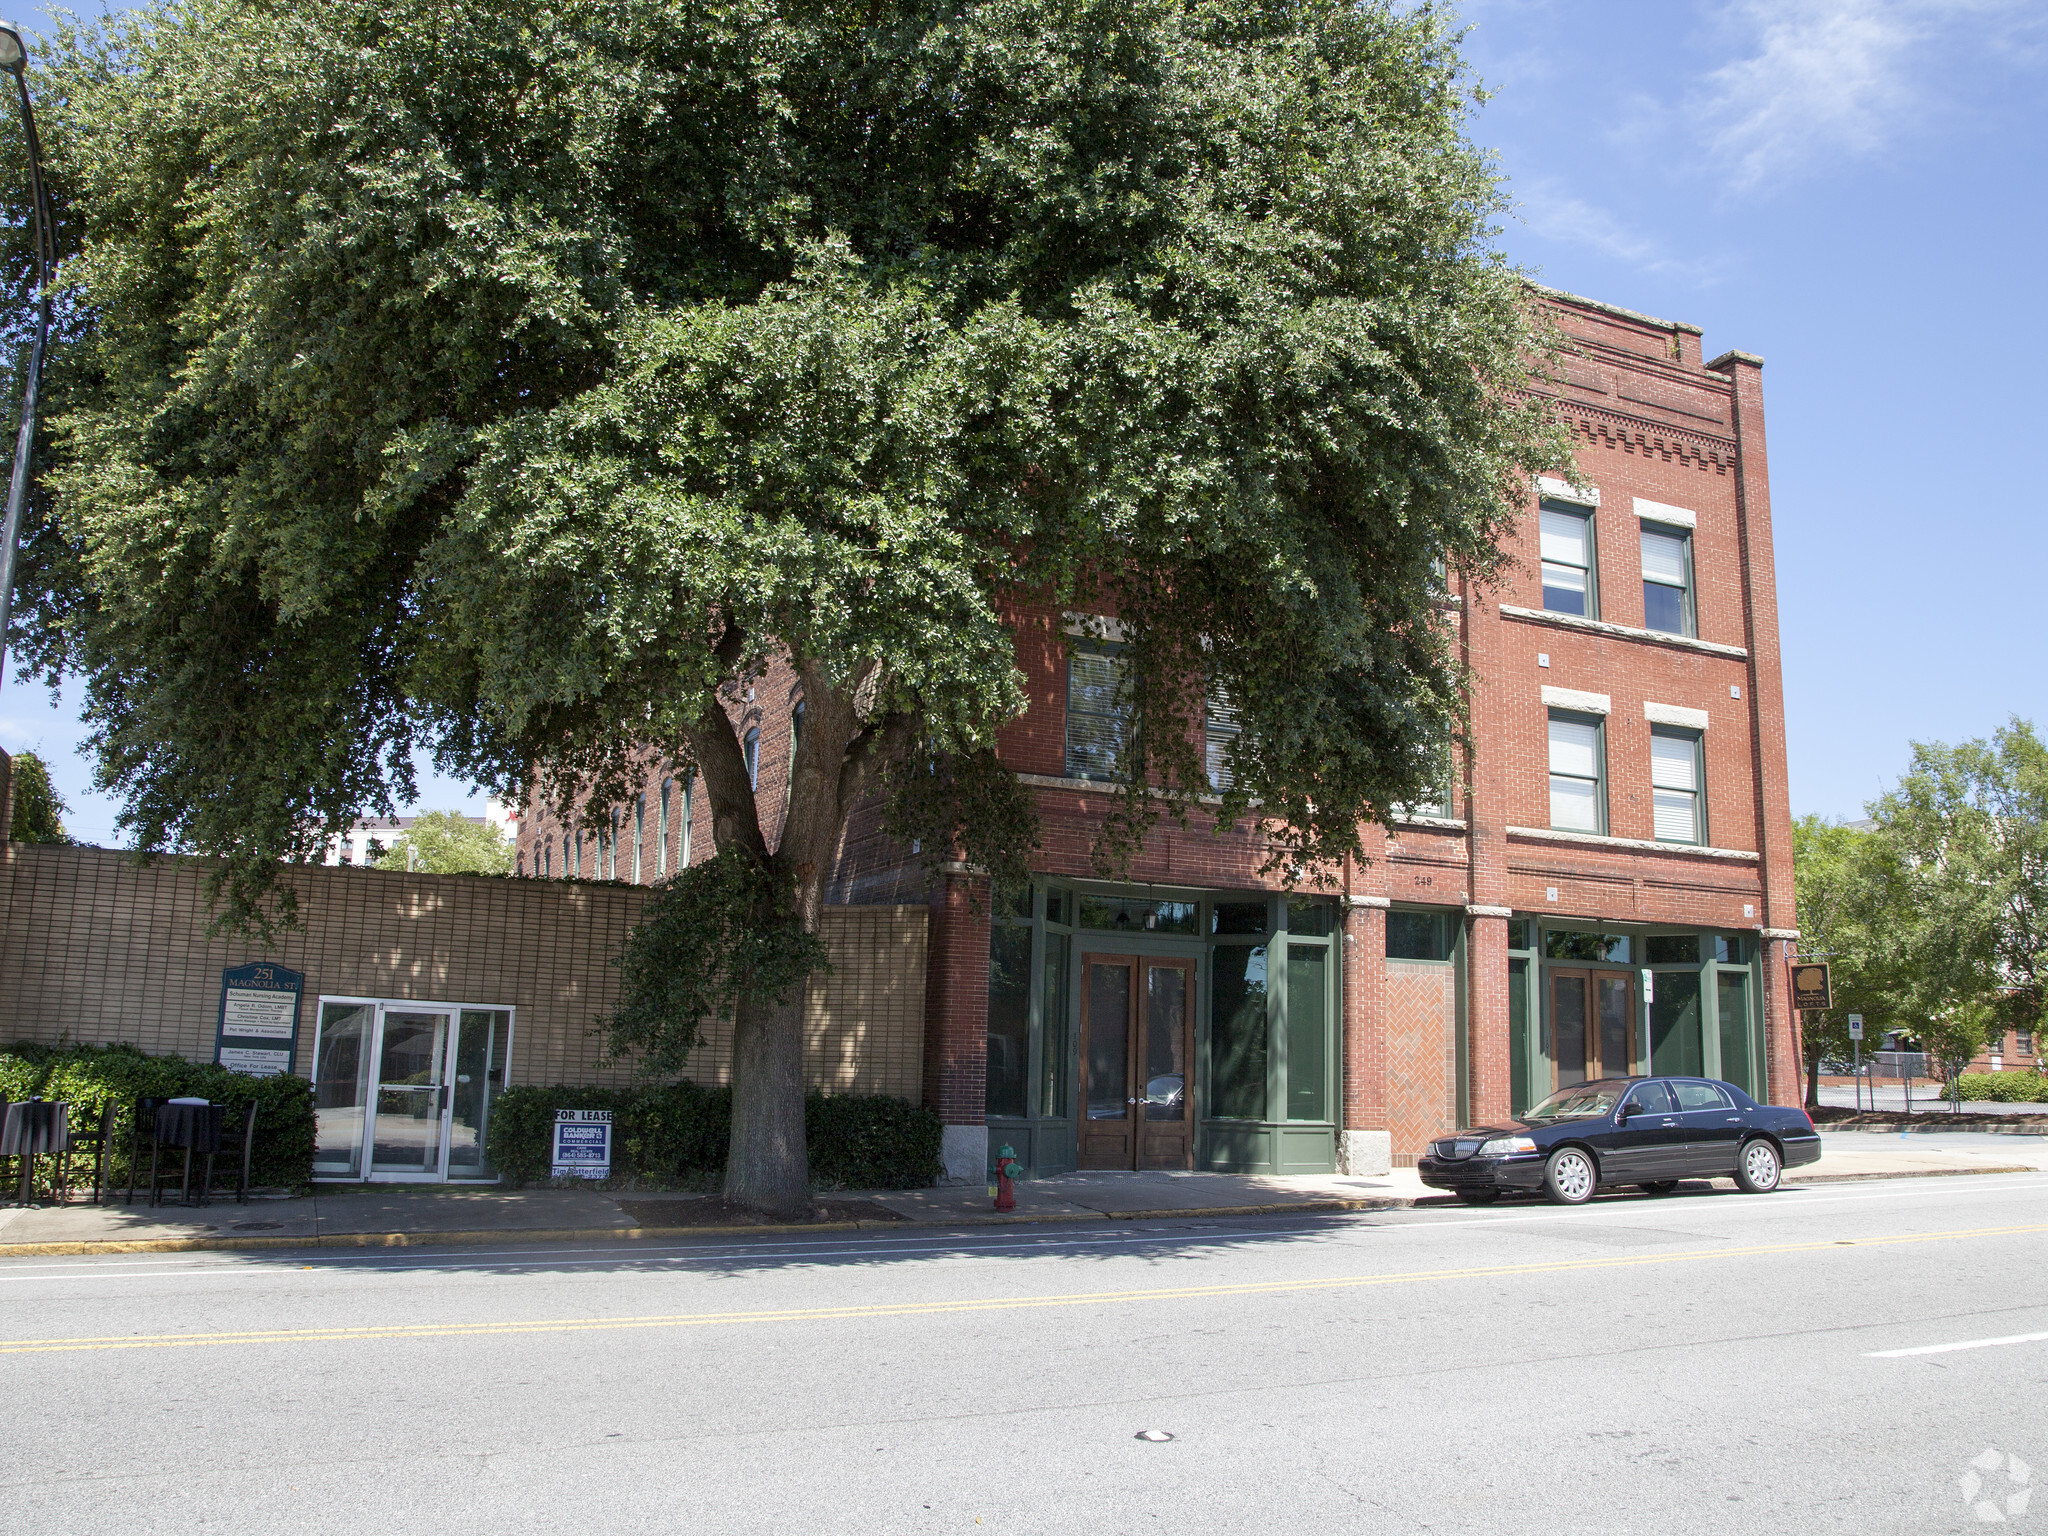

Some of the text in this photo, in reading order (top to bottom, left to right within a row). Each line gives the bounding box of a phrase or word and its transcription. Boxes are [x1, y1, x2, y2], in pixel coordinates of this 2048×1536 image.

[1414, 876, 1432, 886] 249
[254, 967, 274, 980] 251
[229, 978, 298, 990] MAGNOLIA ST.
[555, 1110, 614, 1121] FOR LEASE
